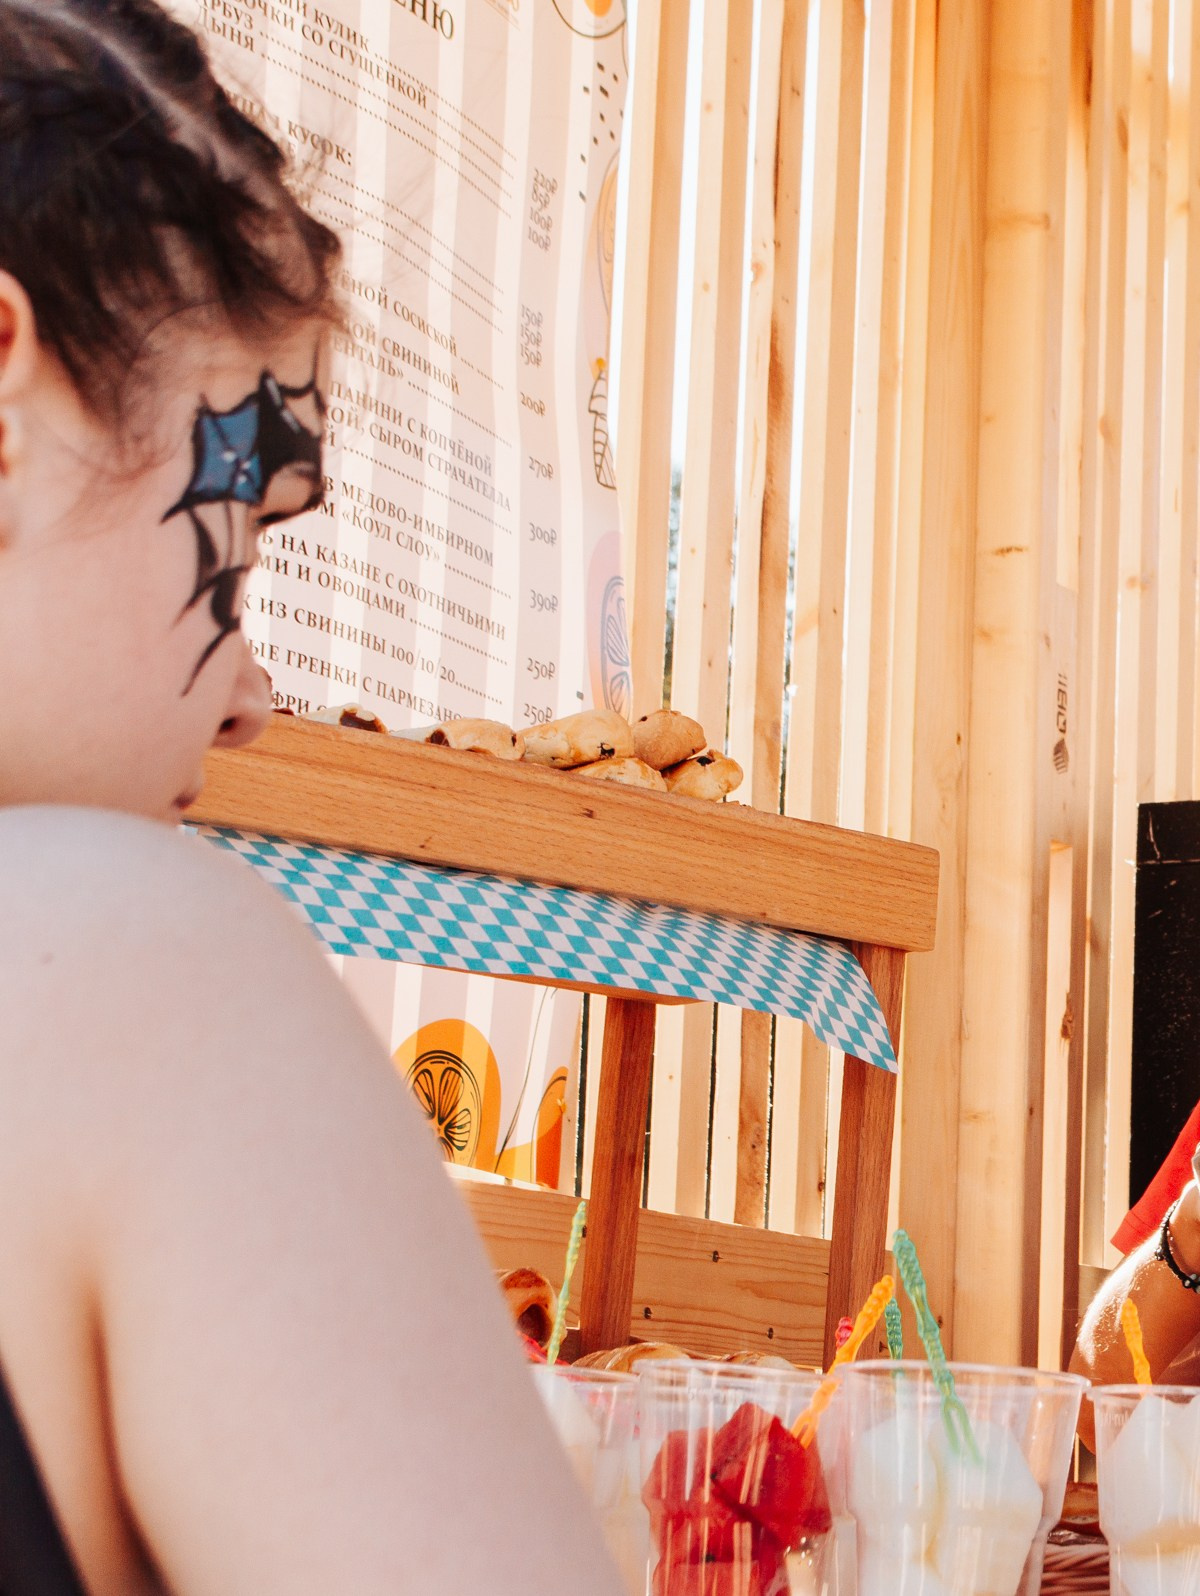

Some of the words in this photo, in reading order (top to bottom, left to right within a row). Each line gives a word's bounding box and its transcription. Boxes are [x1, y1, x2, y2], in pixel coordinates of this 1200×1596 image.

[195, 5, 255, 52] ДЫНЯ
[314, 8, 369, 52] КУЛИК
[235, 0, 294, 32] ОЧКИ
[301, 24, 323, 46] СО
[329, 40, 427, 109] СГУЩЕНКОЙ
[287, 119, 352, 167] КУСОК:
[528, 225, 551, 252] 100₽
[529, 206, 553, 231] 100₽
[393, 300, 457, 357] СОСИСКОЙ
[520, 323, 542, 348] 150₽
[521, 303, 543, 328] 150₽
[382, 337, 460, 395] СВИНИНОЙ
[520, 343, 542, 368] 150₽
[520, 391, 545, 417] 200₽
[330, 381, 403, 427] ПАНИНИ
[407, 417, 416, 434] С
[420, 423, 493, 477] КОПЧЁНОЙ
[369, 422, 424, 462] СЫРОМ
[427, 453, 512, 511] СТРАЧАТЕЛЛА
[528, 455, 554, 481] 270₽
[341, 480, 493, 567] МЕДОВО-ИМБИРНОМ
[529, 521, 557, 546] 300₽
[281, 533, 309, 556] НА
[316, 544, 381, 583] КАЗАНЕ
[385, 572, 394, 589] С
[398, 578, 505, 641] ОХОТНИЧЬИМИ
[297, 563, 311, 583] И
[318, 571, 406, 619] ОВОЩАМИ
[529, 589, 558, 613] 390₽
[260, 596, 287, 619] ИЗ
[294, 608, 386, 655] СВИНИНЫ
[286, 648, 357, 687] ГРЕНКИ
[362, 676, 372, 692] С
[527, 657, 555, 680] 250₽
[523, 703, 553, 725] 250₽
